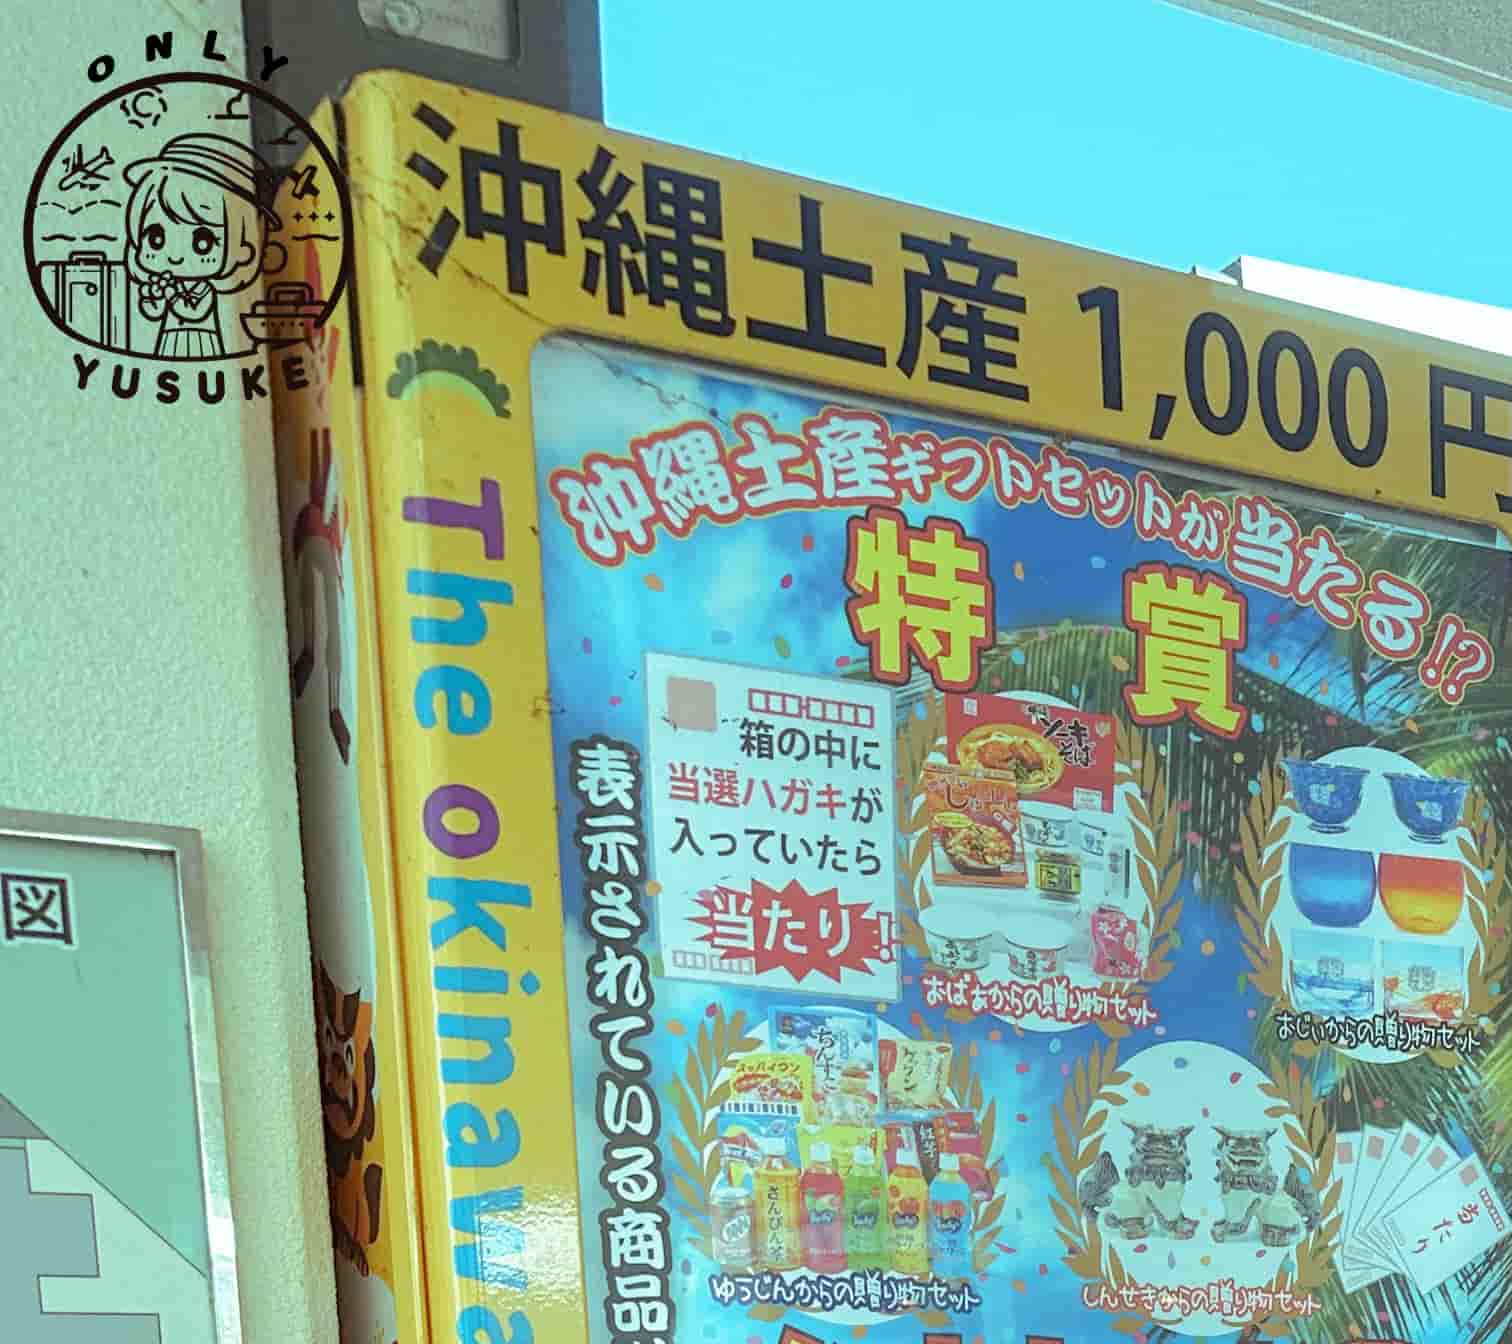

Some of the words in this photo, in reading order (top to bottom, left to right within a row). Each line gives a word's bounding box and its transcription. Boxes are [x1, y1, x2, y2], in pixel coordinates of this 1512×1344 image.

[405, 101, 1031, 403] 沖縄土産
[1076, 285, 1390, 470] 1,000
[402, 477, 514, 738] The
[738, 716, 882, 772] 箱の中に
[668, 760, 884, 826] 当選ハガキが
[669, 816, 882, 878] 入っていたら
[0, 872, 73, 946] 図
